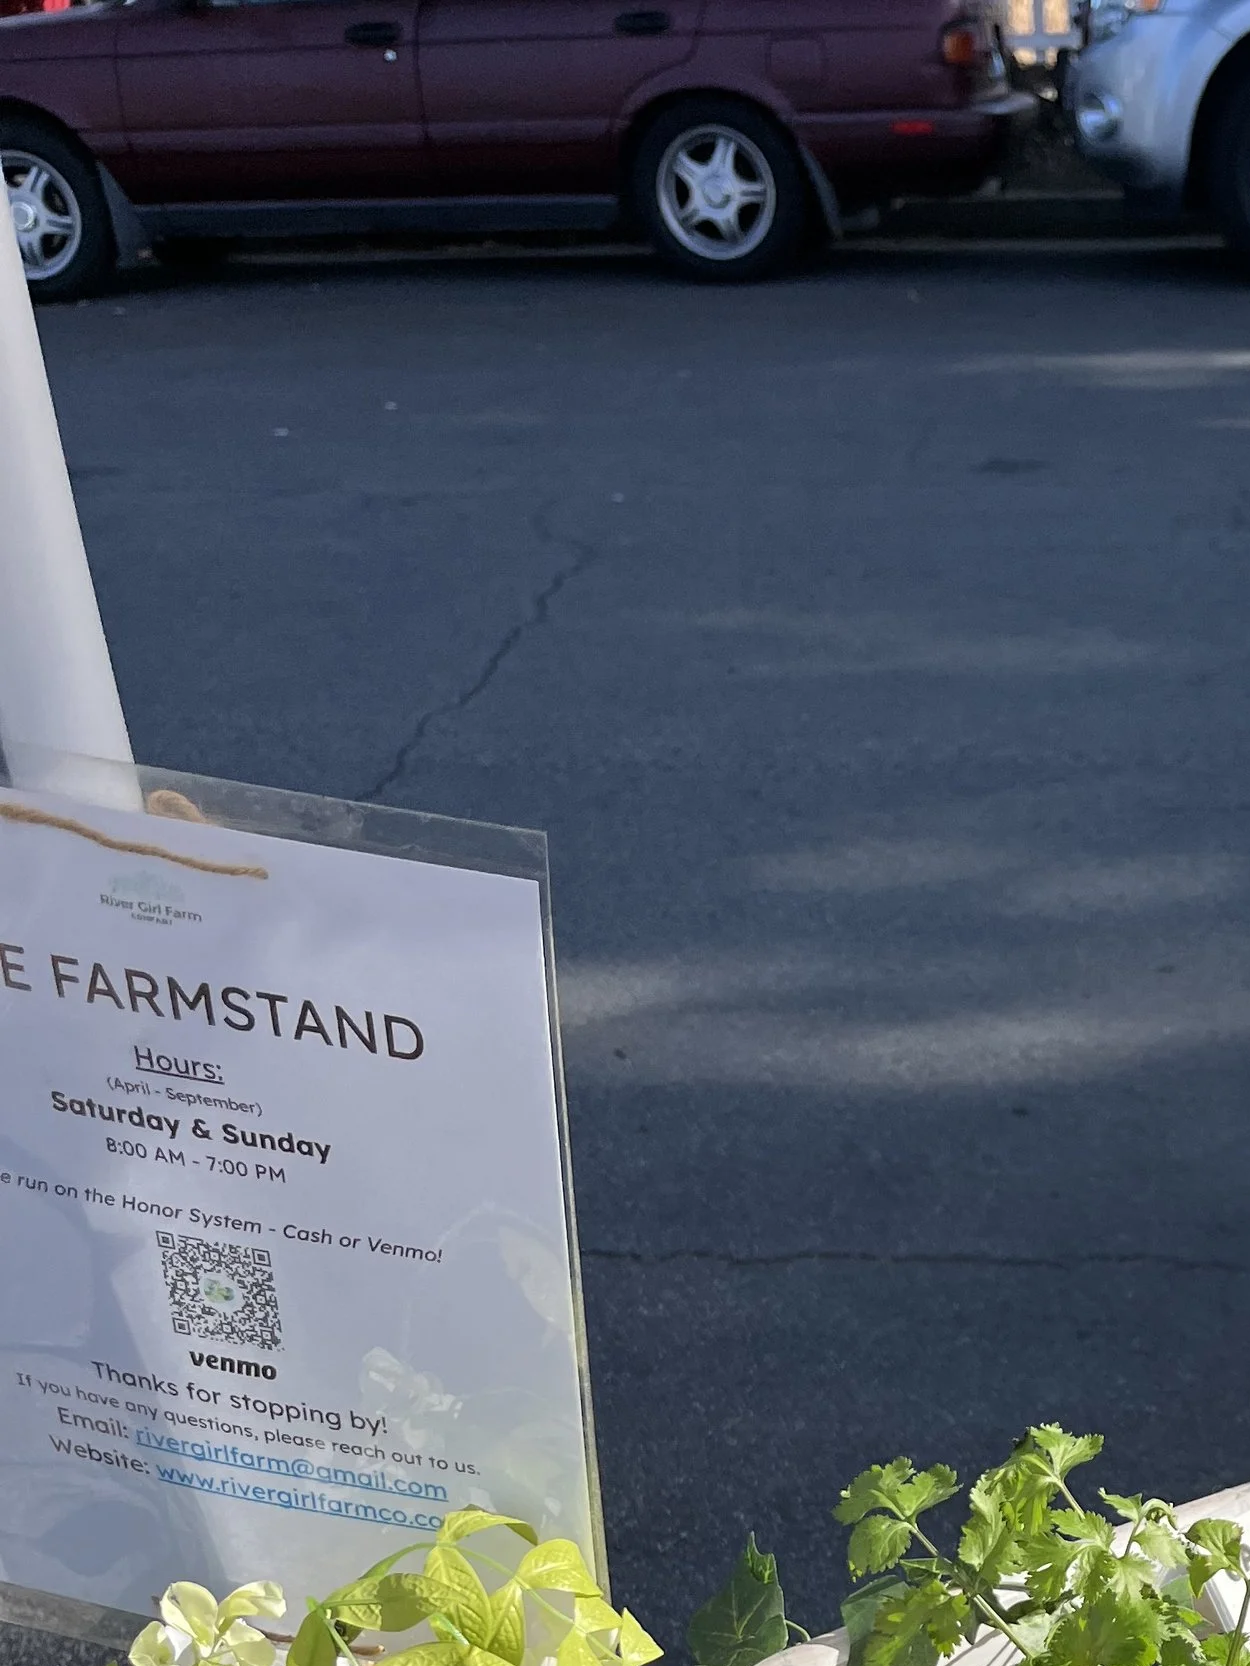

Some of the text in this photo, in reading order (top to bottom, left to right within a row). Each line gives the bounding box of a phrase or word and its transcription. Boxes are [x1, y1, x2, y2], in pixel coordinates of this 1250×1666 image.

[138, 901, 162, 915] Girl
[165, 906, 202, 922] Farm
[50, 954, 425, 1060] FARMSTAND
[106, 1076, 151, 1098] (April
[166, 1087, 263, 1117] September)
[134, 1045, 225, 1084] Hours:
[52, 1091, 332, 1164] Saturday & Sunday
[106, 1137, 147, 1159] 8:00
[154, 1147, 186, 1167] AM
[205, 1156, 248, 1178] 7:00
[255, 1164, 287, 1183] PM
[17, 1176, 48, 1192] run
[54, 1184, 78, 1199] on
[84, 1188, 115, 1206] the
[122, 1194, 183, 1219] Honor
[189, 1208, 262, 1235] System
[283, 1224, 333, 1245] Cash
[339, 1235, 361, 1249] or
[368, 1236, 443, 1263] Venmo!
[91, 1360, 388, 1437] Thanks for stopping by!
[190, 1350, 277, 1380] venmo
[16, 1372, 482, 1476] If you have any questions, please reach out to us.
[57, 1406, 449, 1502] Email: rivergirlfarm@gmail.com
[49, 1434, 444, 1532] Website: www.rivergirlfarmco.co
